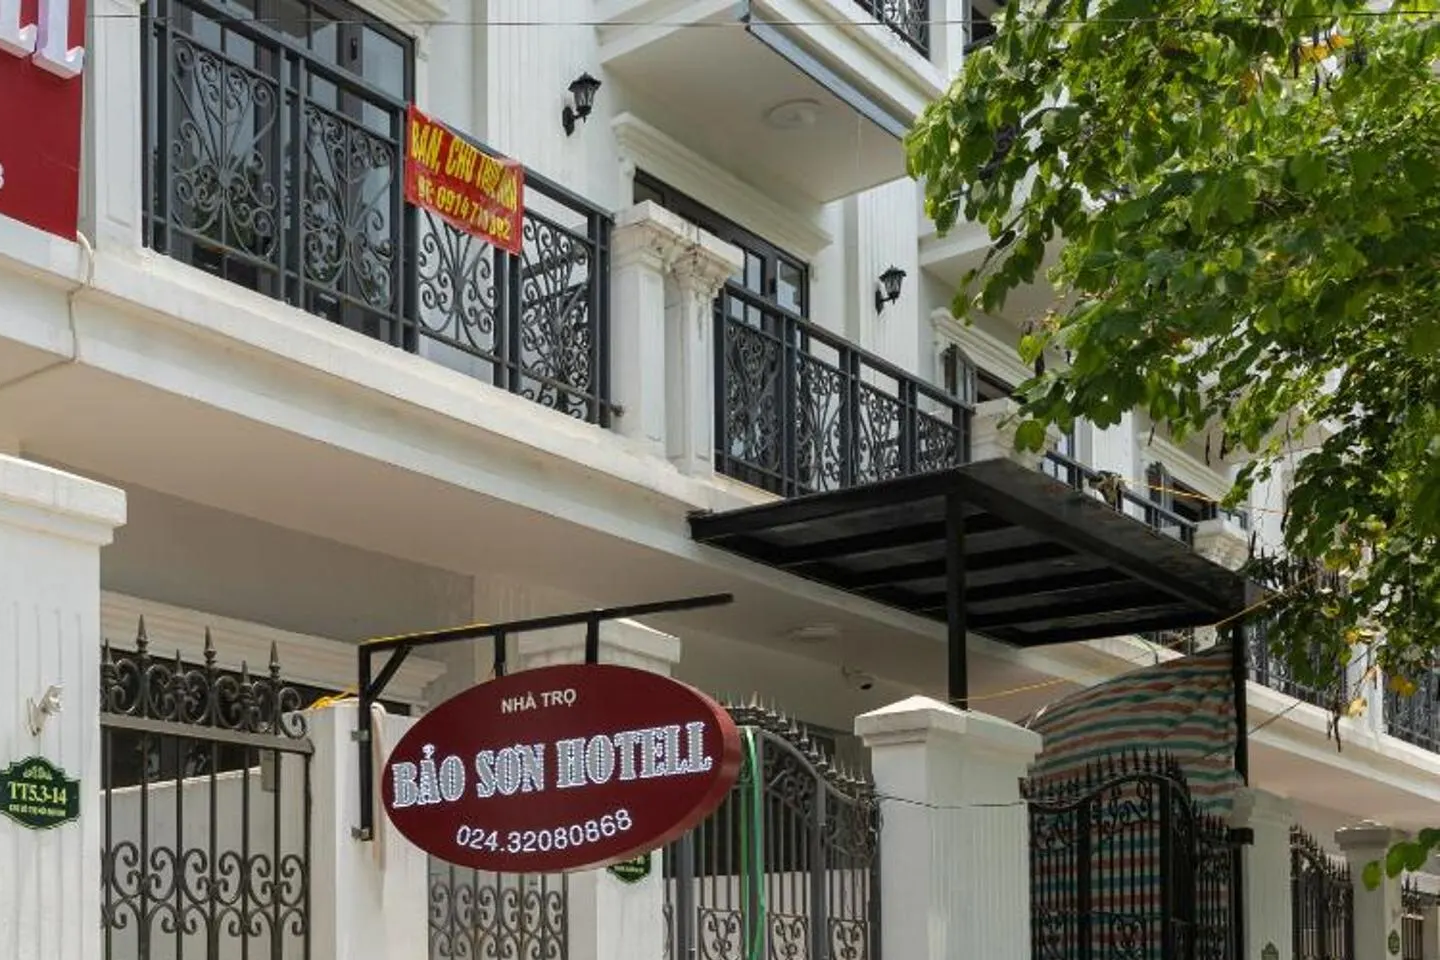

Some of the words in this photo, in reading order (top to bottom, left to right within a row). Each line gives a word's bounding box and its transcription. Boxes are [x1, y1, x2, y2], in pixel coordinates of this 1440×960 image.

[501, 689, 537, 714] NHÀ
[541, 688, 578, 708] TRỌ
[392, 743, 466, 808] BẢO
[556, 721, 713, 788] HOTELL
[456, 809, 633, 853] 024.32080868
